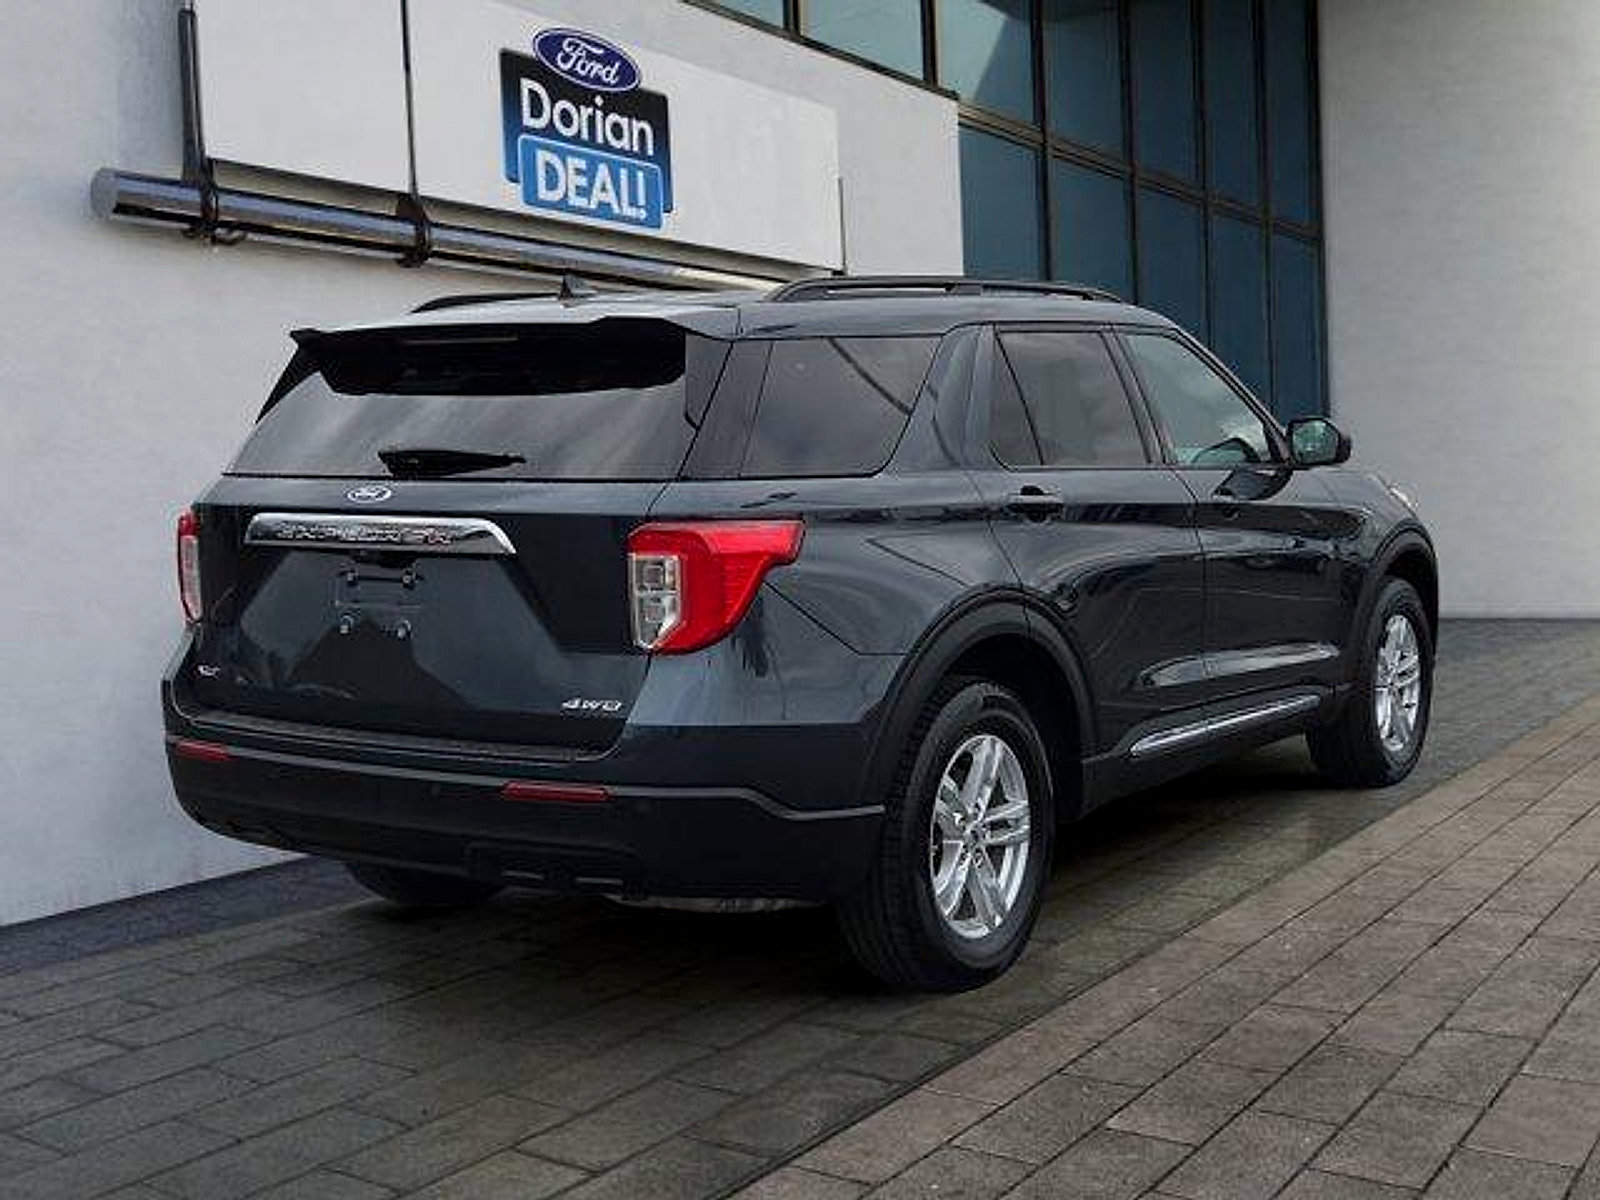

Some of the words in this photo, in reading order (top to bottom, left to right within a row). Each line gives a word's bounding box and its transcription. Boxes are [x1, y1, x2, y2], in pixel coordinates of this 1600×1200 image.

[557, 37, 620, 84] Ford
[520, 77, 654, 156] Dorian
[536, 149, 647, 220] DEAL!
[562, 698, 622, 712] 4WD
